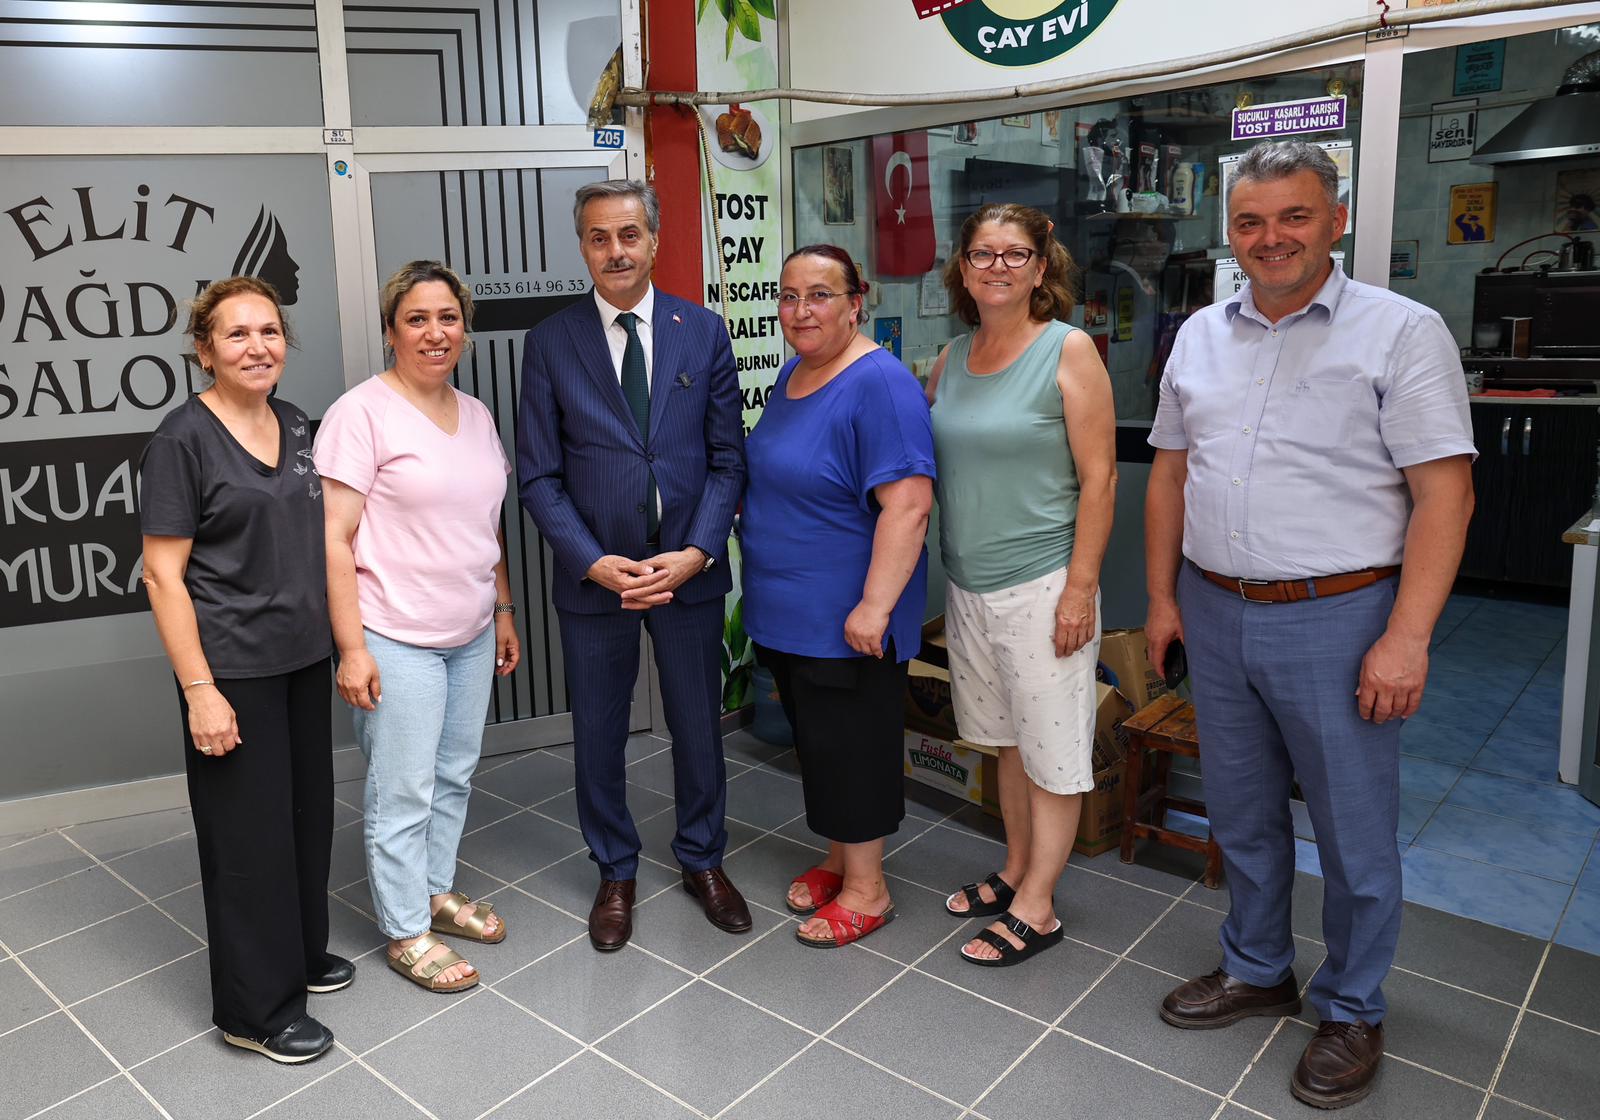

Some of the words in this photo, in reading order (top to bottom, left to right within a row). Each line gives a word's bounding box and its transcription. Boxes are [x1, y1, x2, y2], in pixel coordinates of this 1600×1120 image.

[978, 25, 1034, 54] ÇAY
[1042, 1, 1089, 42] EVİ
[1238, 110, 1269, 123] SUCUKLU
[1274, 105, 1305, 119] KAŞARLI
[1310, 102, 1340, 115] KARIŞIK
[1238, 122, 1271, 135] TOST
[1274, 115, 1339, 131] BULUNUR
[1435, 129, 1465, 141] sen
[596, 130, 621, 146] Z05
[716, 193, 768, 221] TOST
[721, 236, 764, 272] ÇAY
[475, 282, 511, 296] 0533
[515, 281, 541, 294] 614
[546, 279, 564, 293] 96
[568, 279, 585, 292] 33
[921, 737, 953, 762] Fuska
